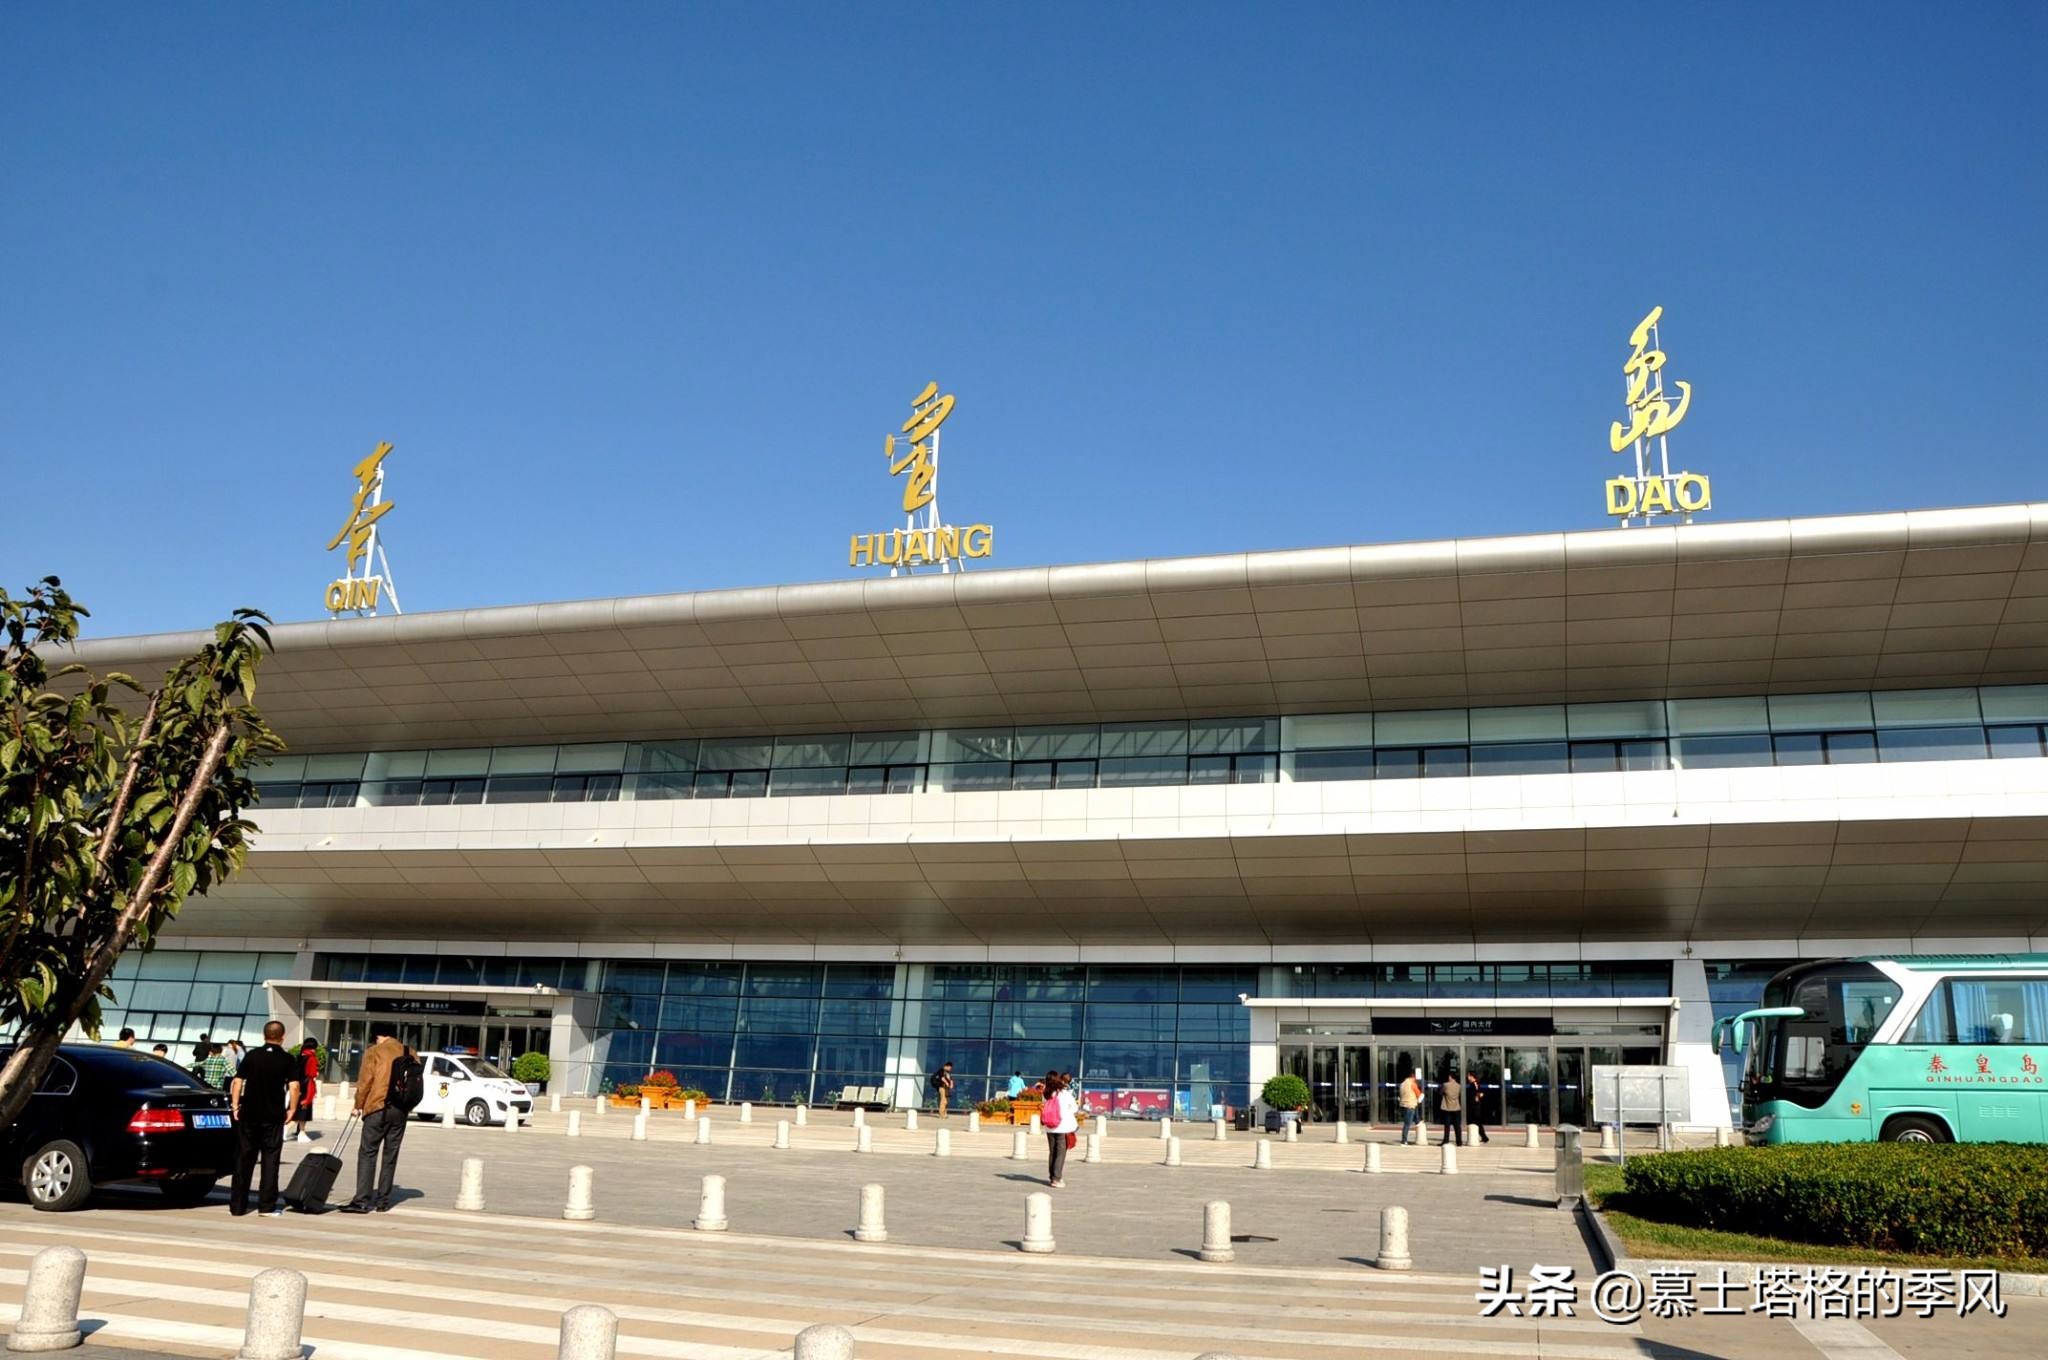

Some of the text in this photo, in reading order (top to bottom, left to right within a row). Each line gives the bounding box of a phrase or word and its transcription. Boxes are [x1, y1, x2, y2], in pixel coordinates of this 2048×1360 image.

[326, 474, 1711, 610] QIN HUANG DAO
